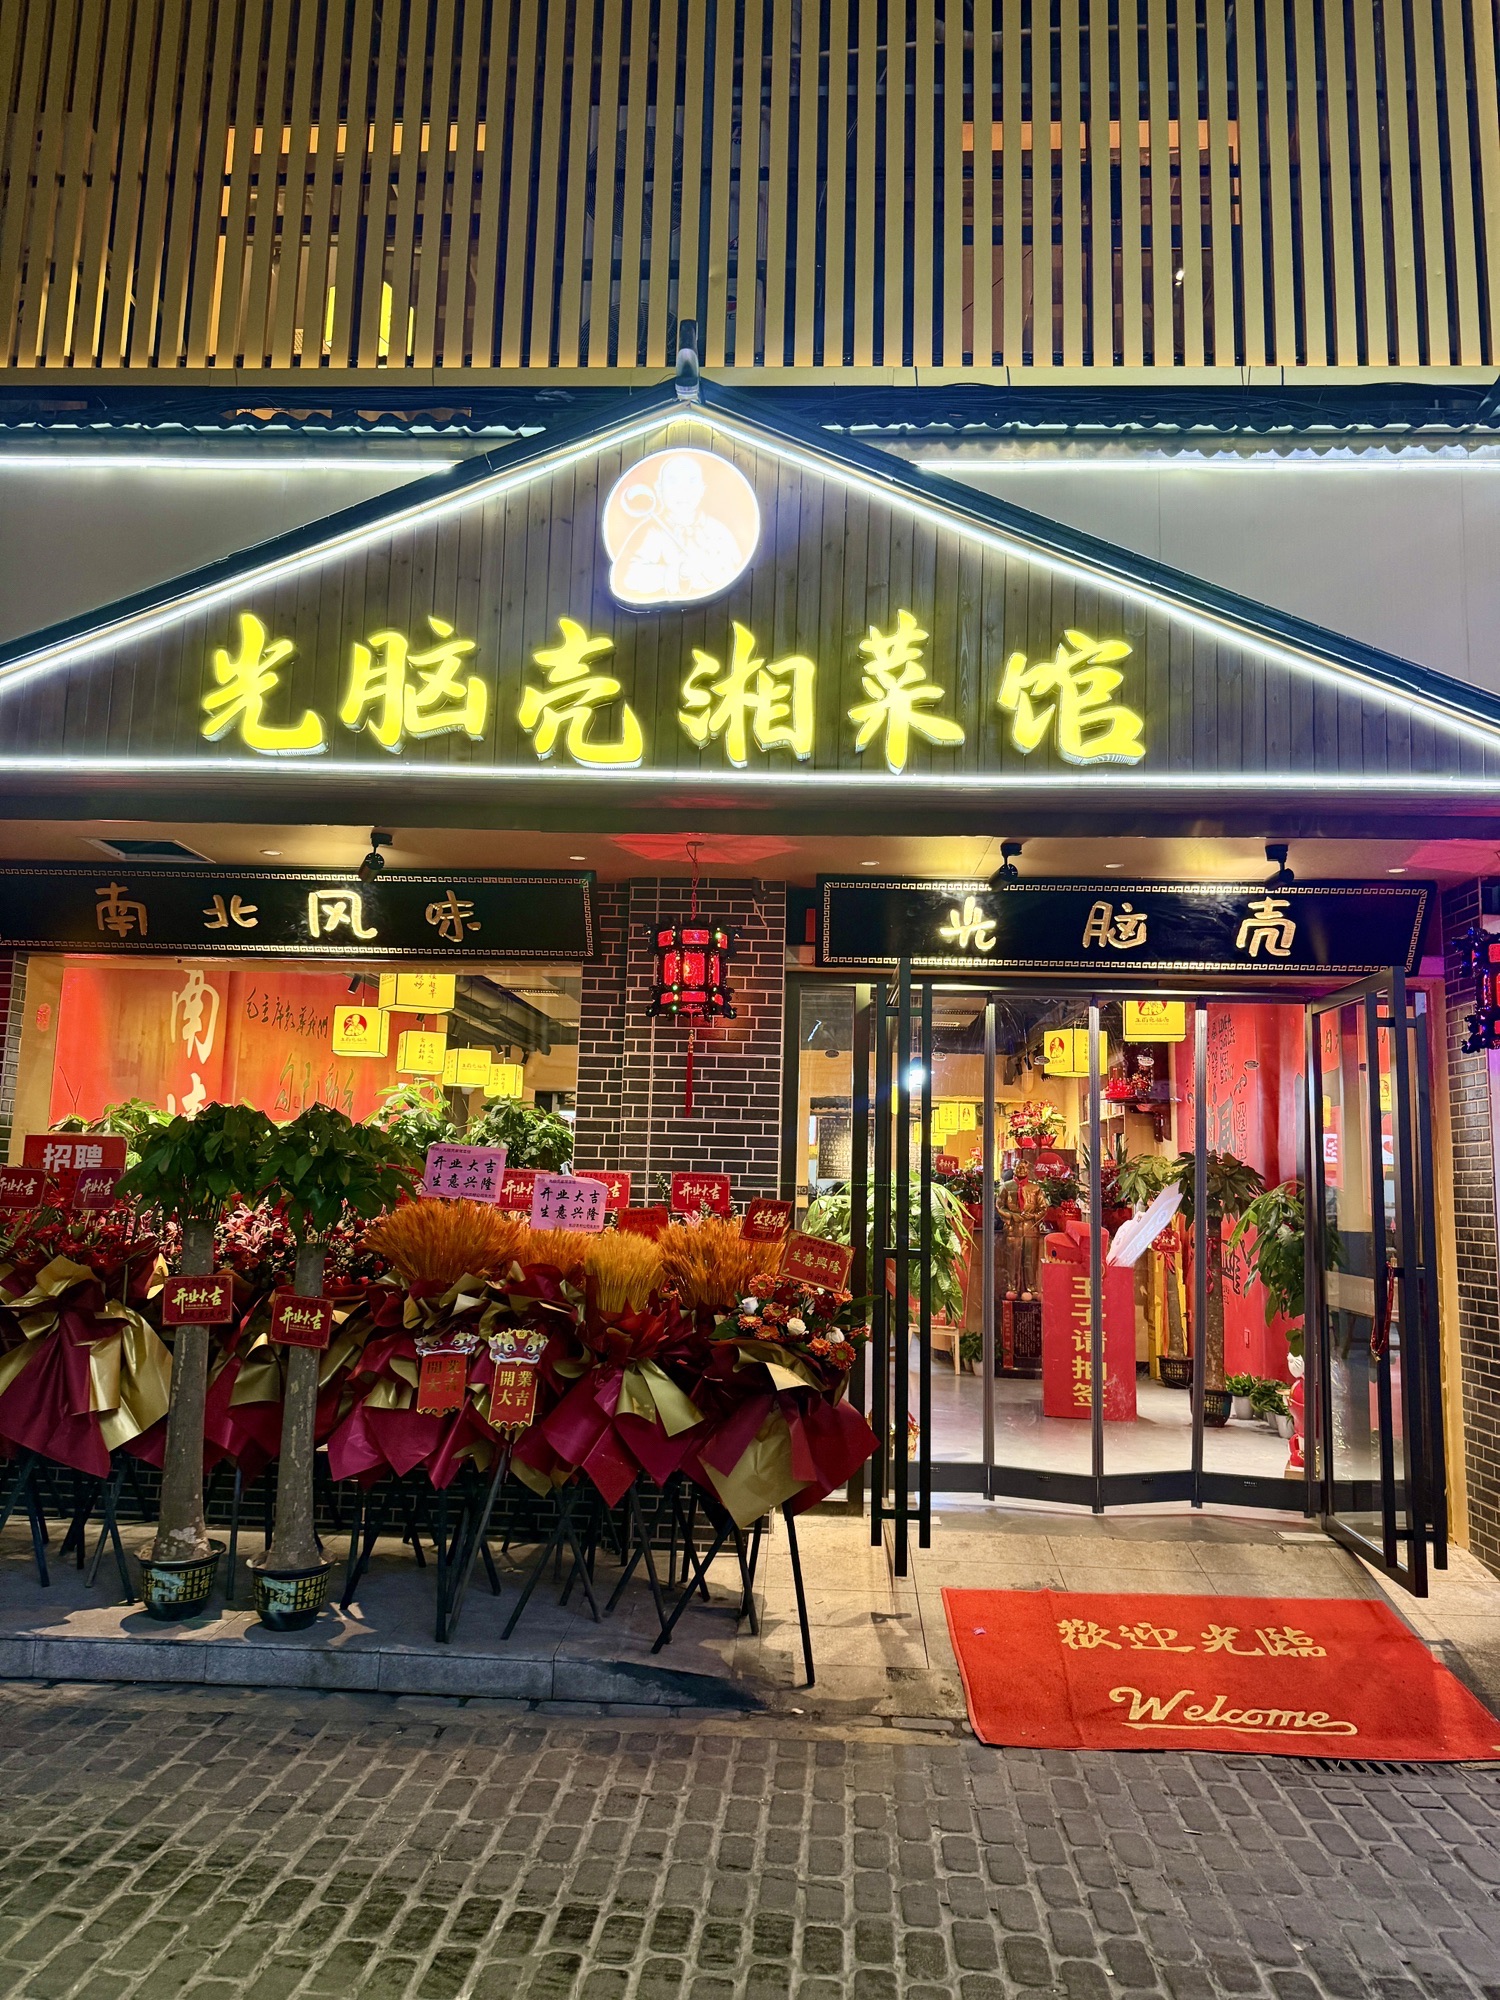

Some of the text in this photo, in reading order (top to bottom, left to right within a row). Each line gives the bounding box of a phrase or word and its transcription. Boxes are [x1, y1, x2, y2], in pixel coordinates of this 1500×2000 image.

[202, 609, 1147, 772] 光脑壳湘菜馆
[96, 881, 481, 943] 南北风味
[940, 895, 1297, 957] 光脑壳
[42, 1142, 103, 1173] 招聘
[432, 1155, 497, 1174] 开业大吉
[81, 1177, 115, 1203] 开业大吉
[431, 1173, 496, 1191] 生意兴隆
[502, 1179, 534, 1203] 开业大
[679, 1181, 722, 1204] 开业大吉
[540, 1187, 601, 1204] 开业大吉
[540, 1203, 600, 1221] 生意兴隆
[171, 1285, 225, 1314] 开业大吉
[279, 1306, 325, 1334] 开业大吉
[499, 1370, 533, 1388] 開業
[497, 1389, 530, 1407] 大吉
[1056, 1618, 1327, 1658] 歡迎光臨
[1108, 1686, 1358, 1736] Welcome
